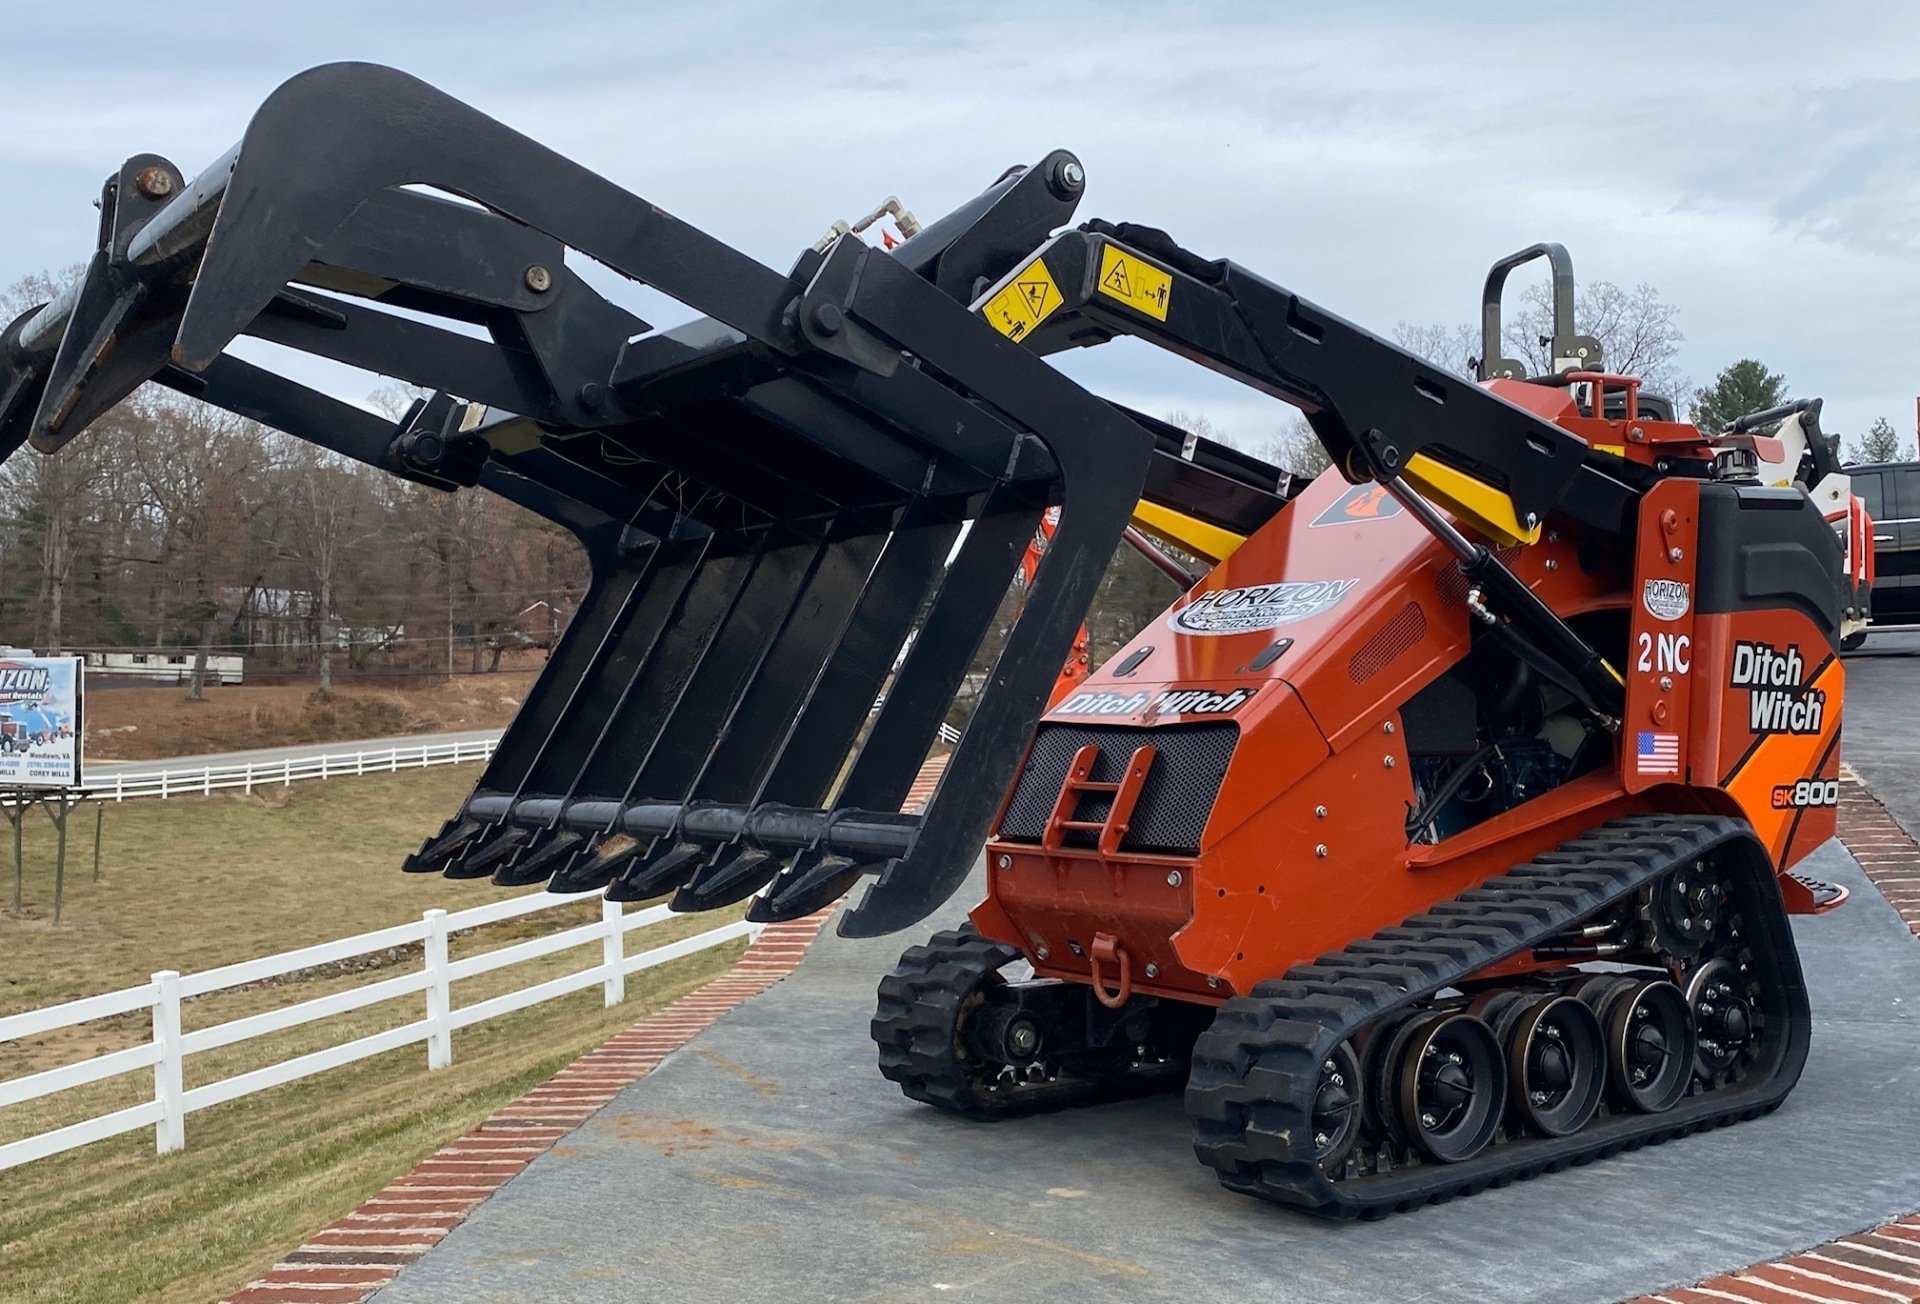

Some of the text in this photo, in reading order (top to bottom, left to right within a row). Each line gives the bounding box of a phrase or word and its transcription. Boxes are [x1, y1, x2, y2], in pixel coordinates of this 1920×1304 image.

[1189, 578, 1361, 610] HORIZON
[1645, 580, 1690, 600] HORIZON
[1638, 632, 1690, 674] 2 NC
[1732, 644, 1803, 687] Ditch
[12, 692, 42, 700] Rentals
[1056, 689, 1248, 714] Ditch Witch
[1751, 690, 1822, 731] Witch
[1772, 781, 1839, 806] SK800
